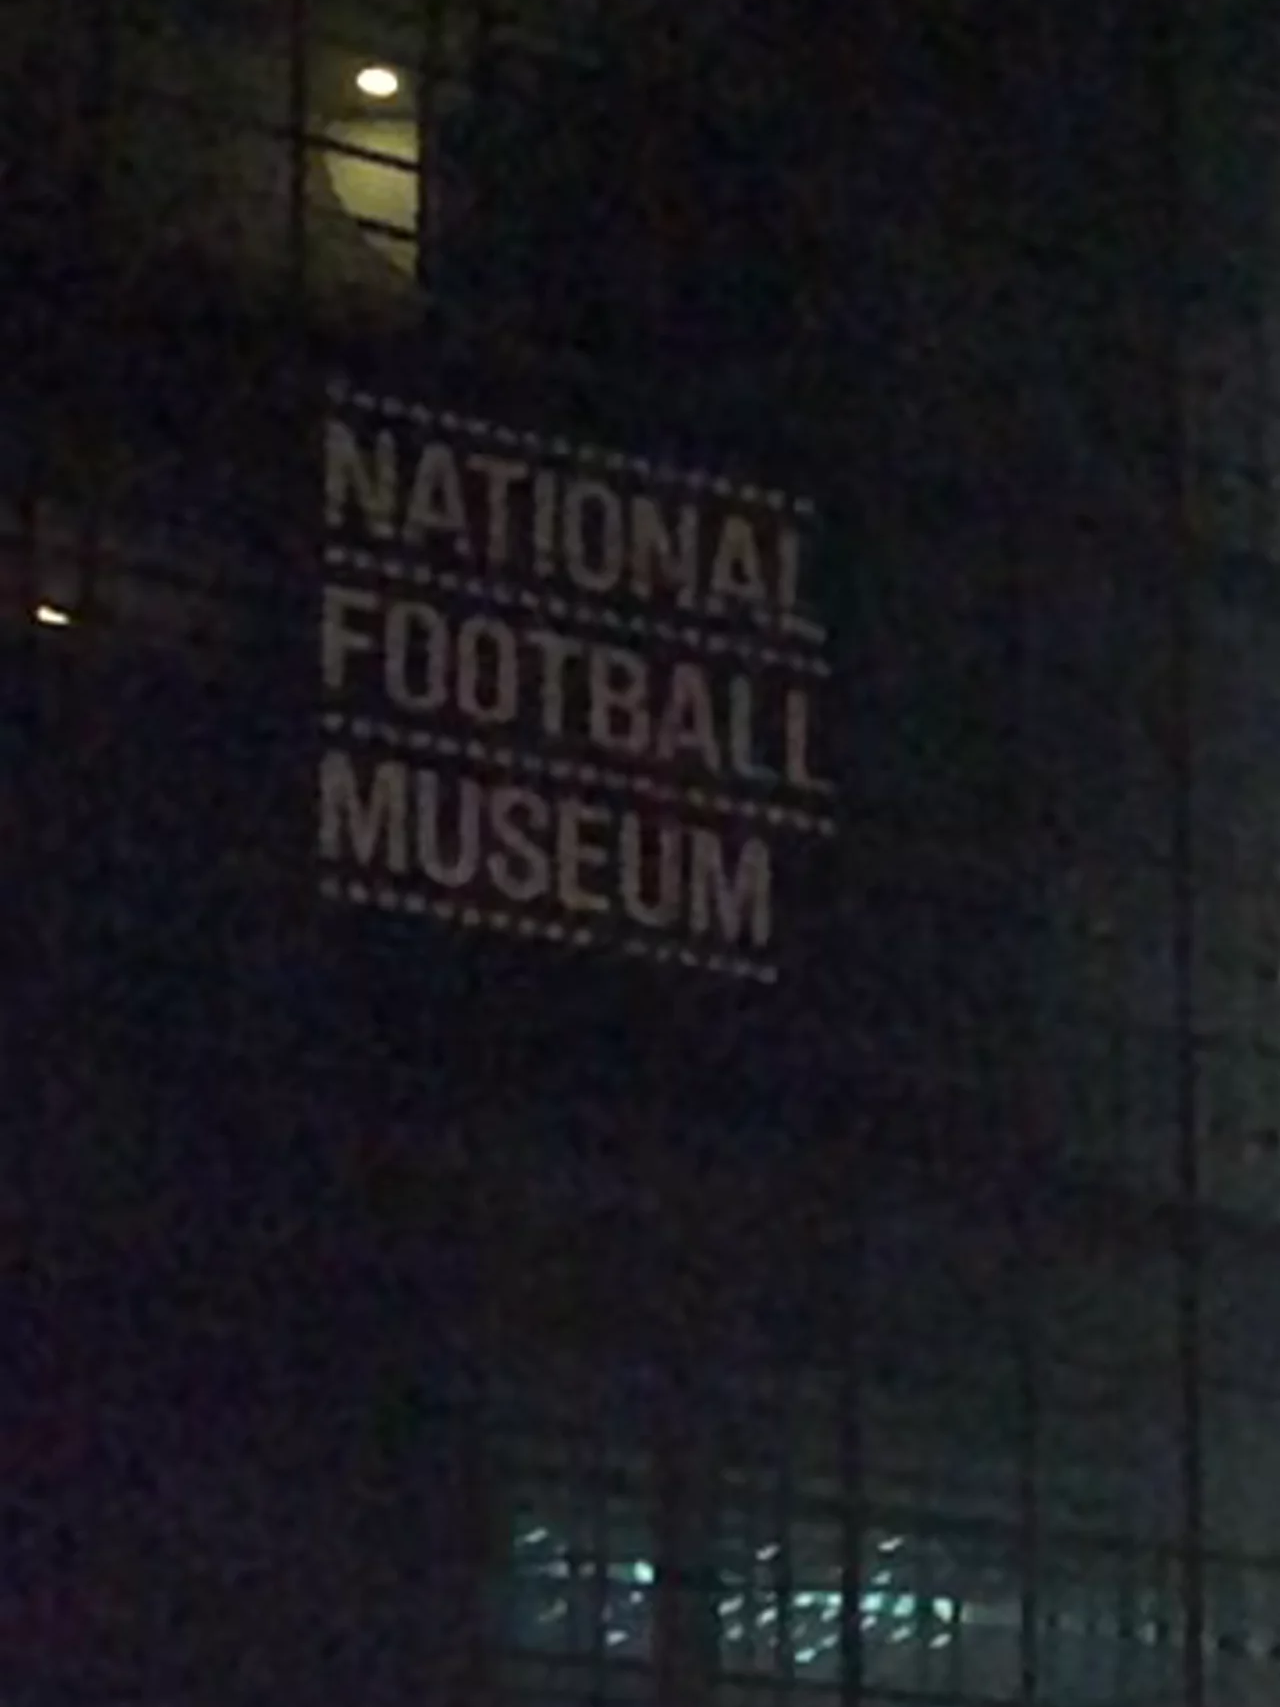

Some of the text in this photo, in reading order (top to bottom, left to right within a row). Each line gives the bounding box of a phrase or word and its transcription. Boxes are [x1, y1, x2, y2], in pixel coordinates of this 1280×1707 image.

[322, 419, 828, 645] NATIONAL
[320, 583, 836, 795] FOOTBALL
[318, 748, 773, 948] MUSEUM
